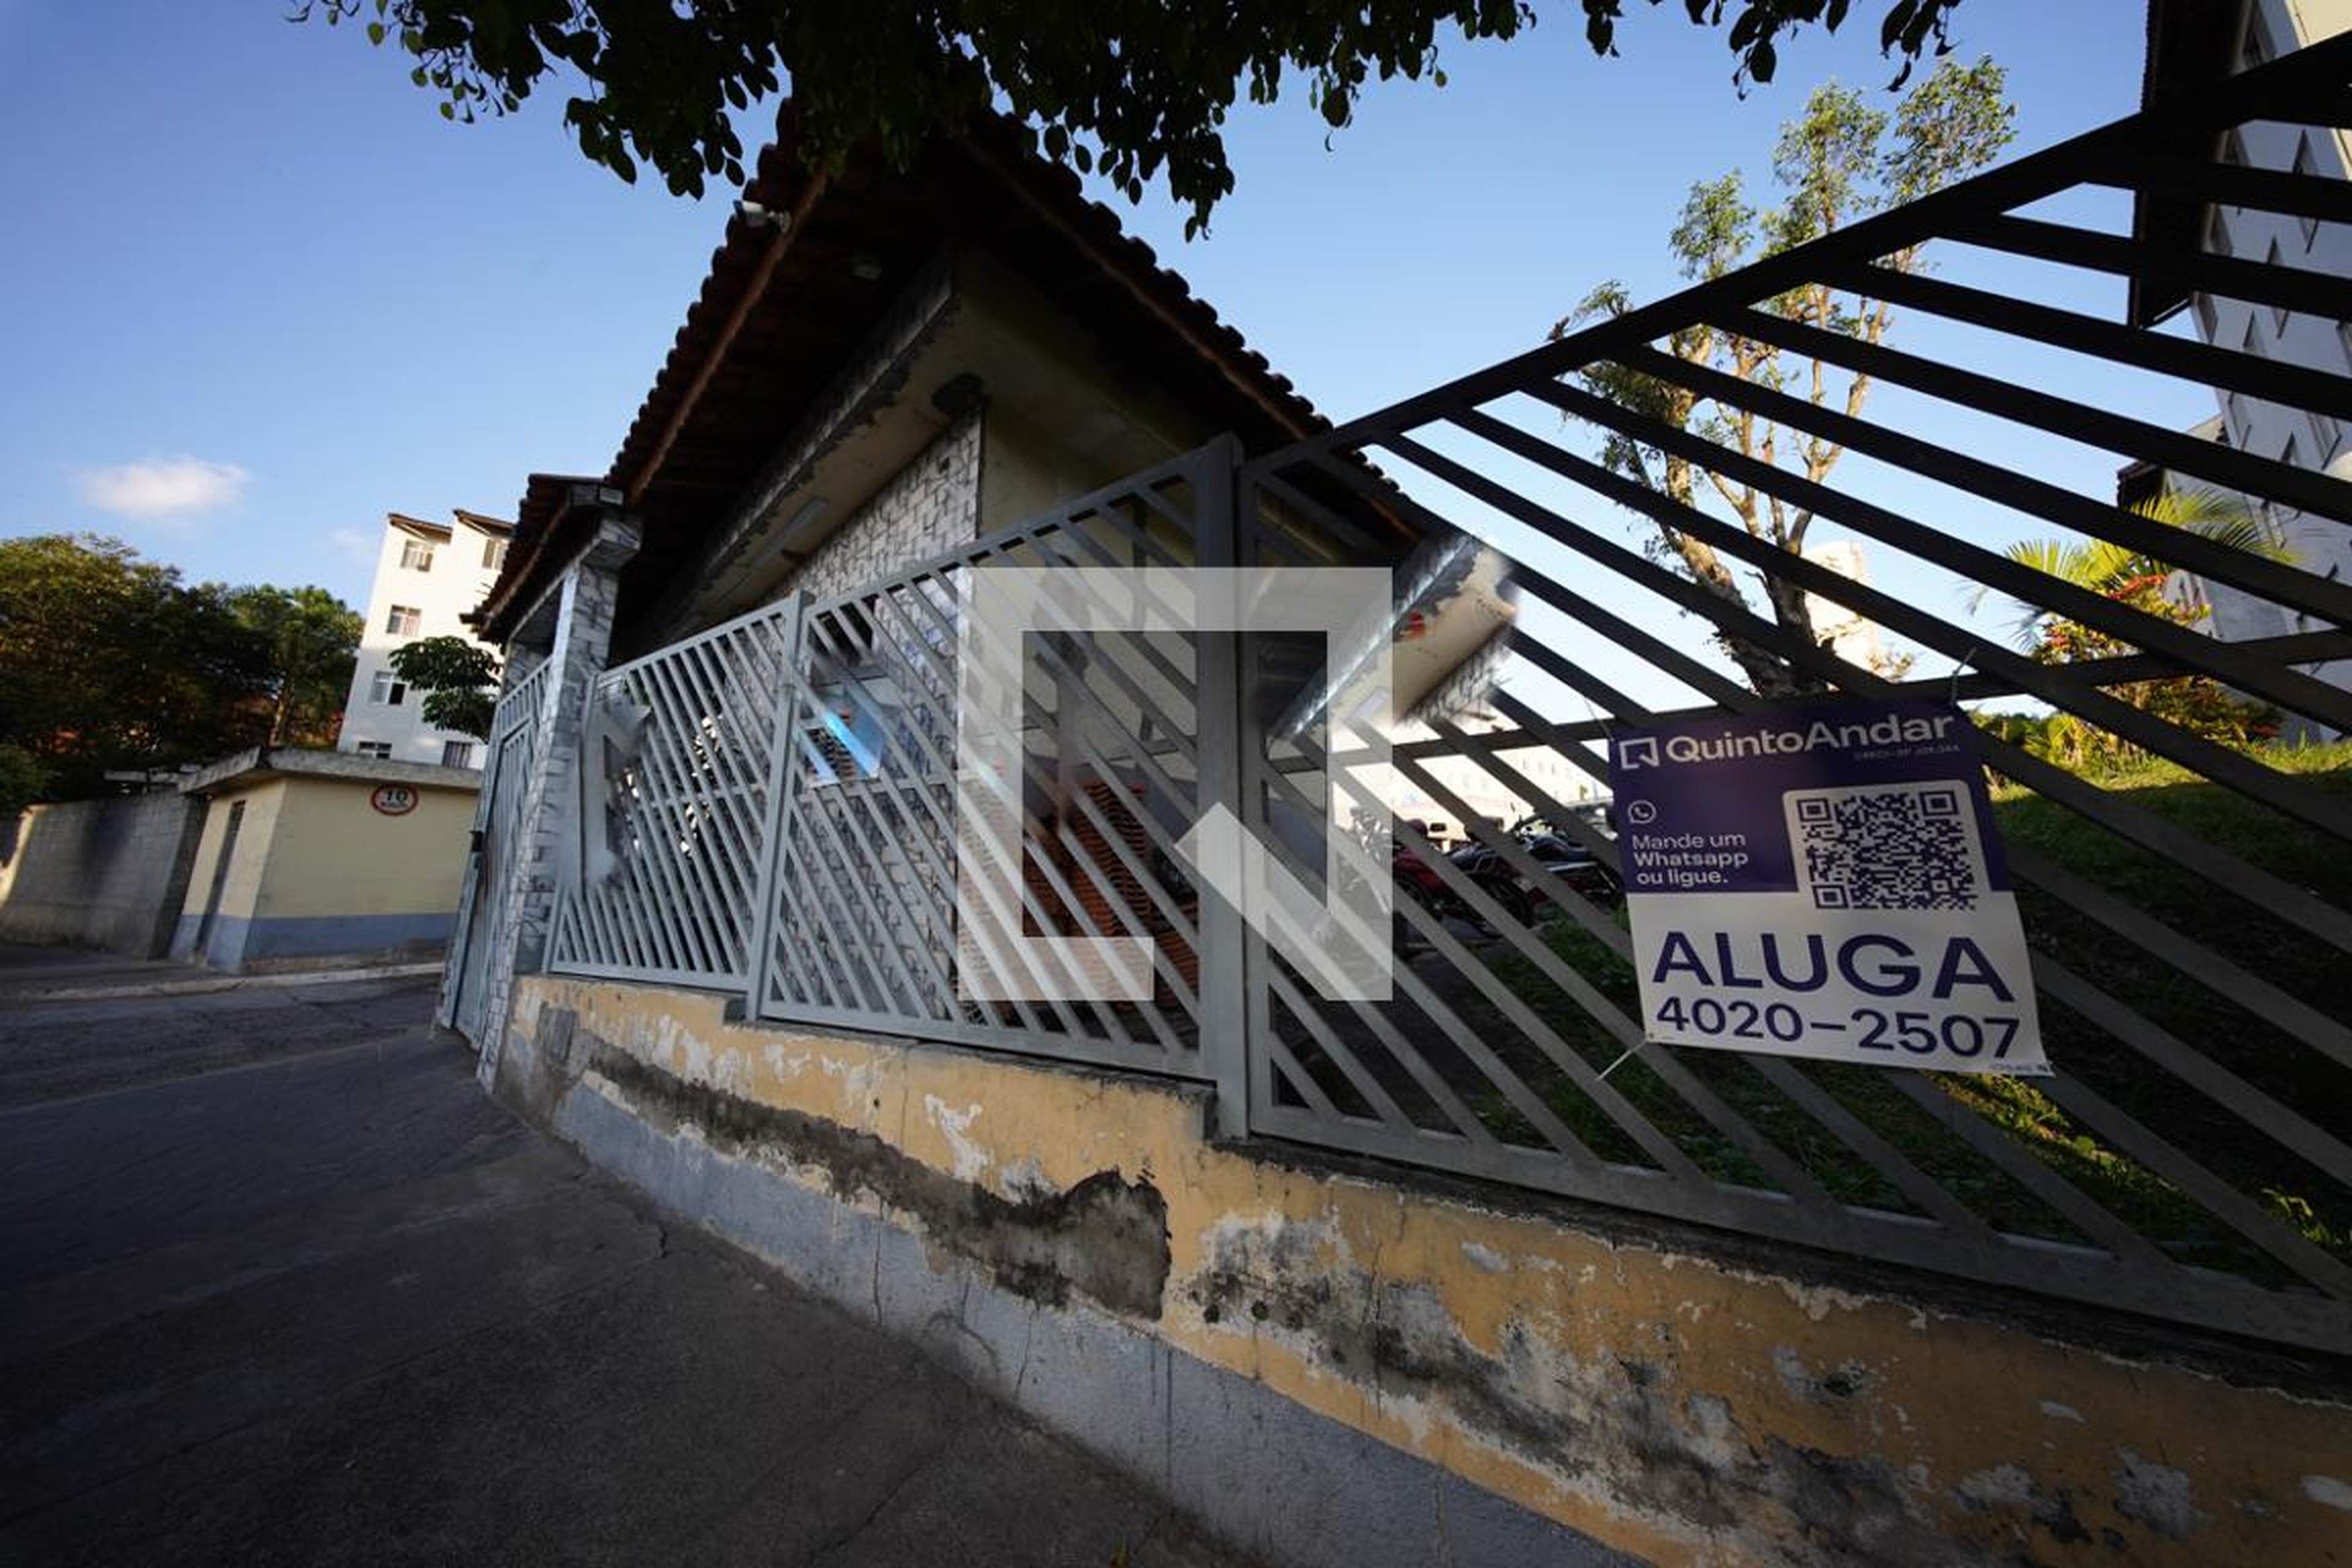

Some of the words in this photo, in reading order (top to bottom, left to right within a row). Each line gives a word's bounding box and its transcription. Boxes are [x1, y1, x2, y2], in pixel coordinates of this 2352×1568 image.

[1666, 714, 1954, 763] QuintoAndar
[1632, 834, 1703, 850] Mande
[1710, 834, 1746, 847] um
[1634, 852, 1748, 867] Whatsapp
[1637, 873, 1663, 884] ou
[1668, 869, 1728, 887] ligue.
[1653, 931, 2015, 1002] ALUGA
